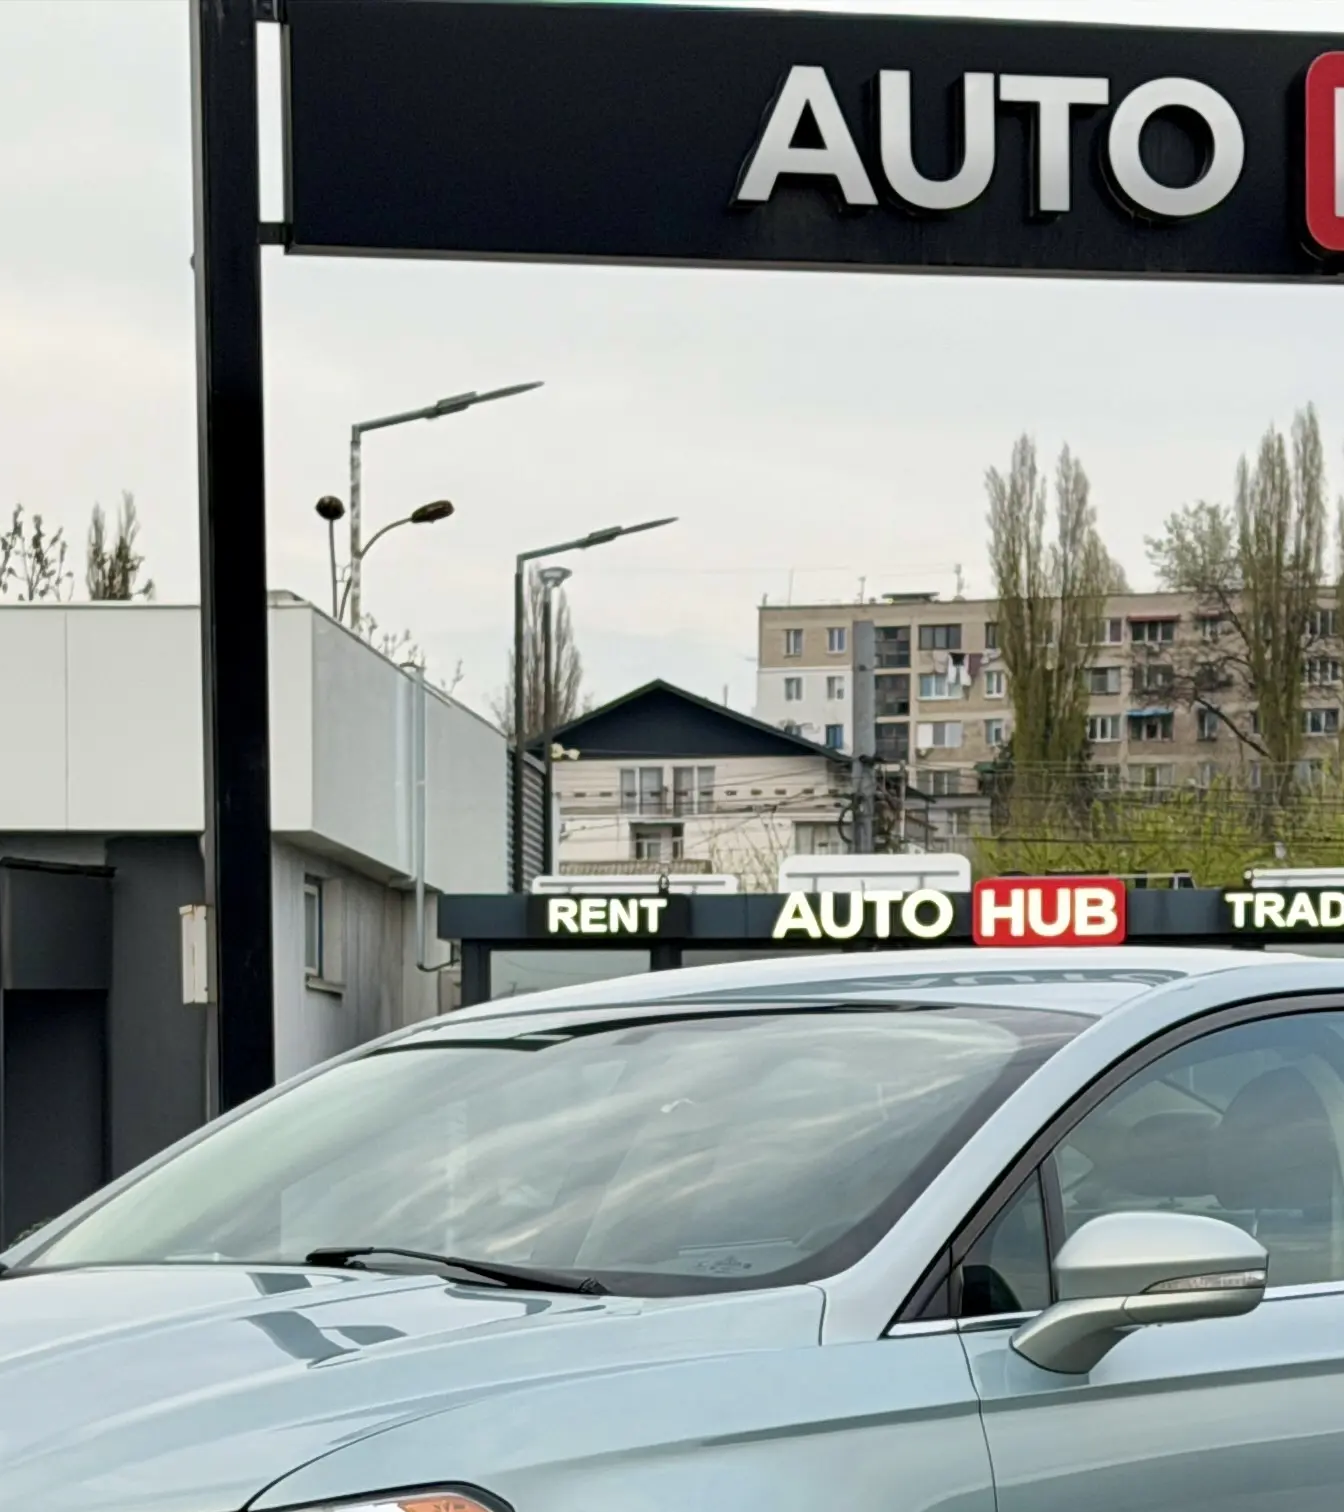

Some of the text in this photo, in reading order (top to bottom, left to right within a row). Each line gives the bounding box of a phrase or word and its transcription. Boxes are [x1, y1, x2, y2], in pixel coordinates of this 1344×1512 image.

[736, 64, 1246, 217] AUTO
[547, 898, 668, 934] RENT
[772, 887, 1120, 939] AUTO HUB
